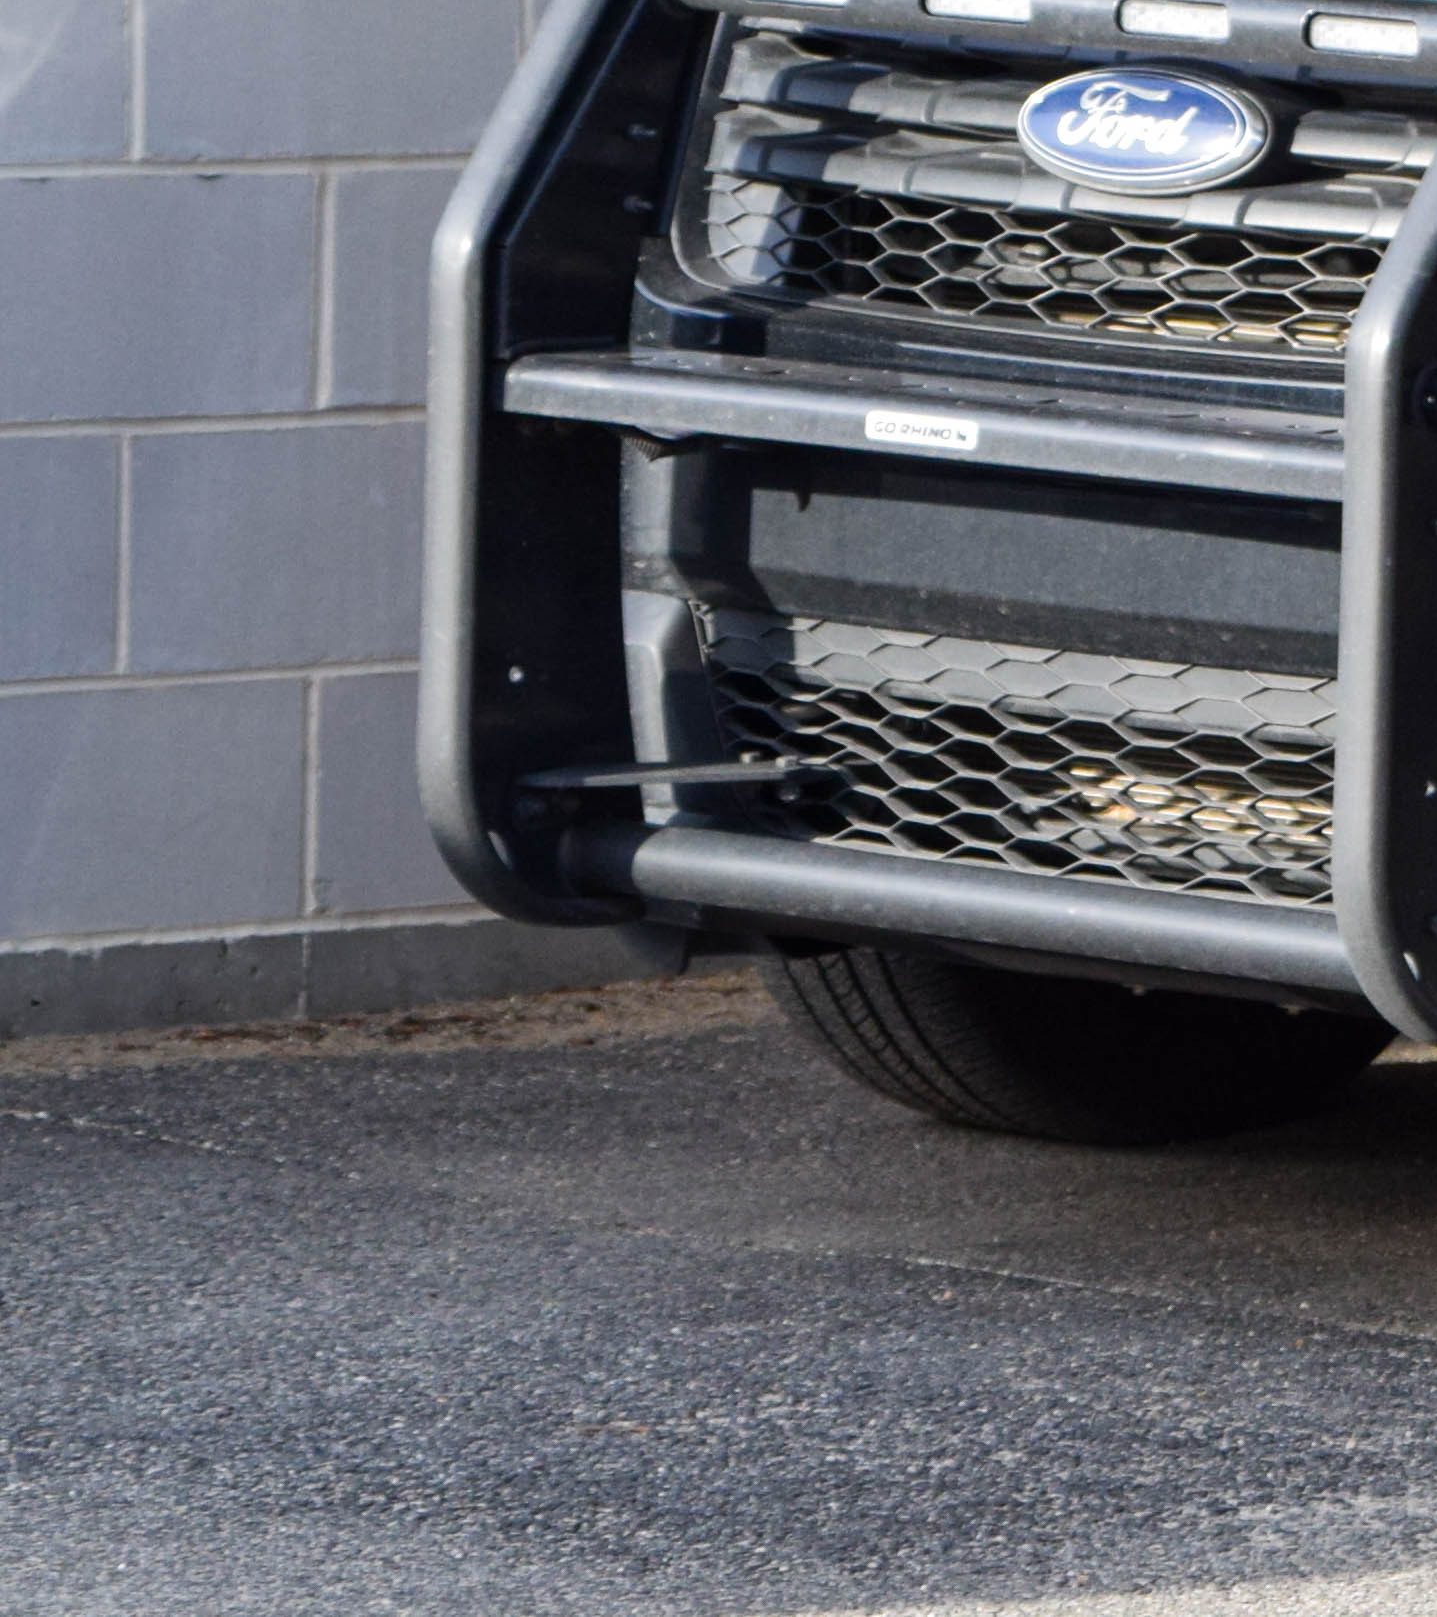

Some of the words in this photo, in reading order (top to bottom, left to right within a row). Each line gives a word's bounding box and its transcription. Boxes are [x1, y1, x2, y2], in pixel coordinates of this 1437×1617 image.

[1056, 81, 1199, 155] Ford
[874, 421, 897, 434] GO
[900, 424, 952, 440] RHINO
